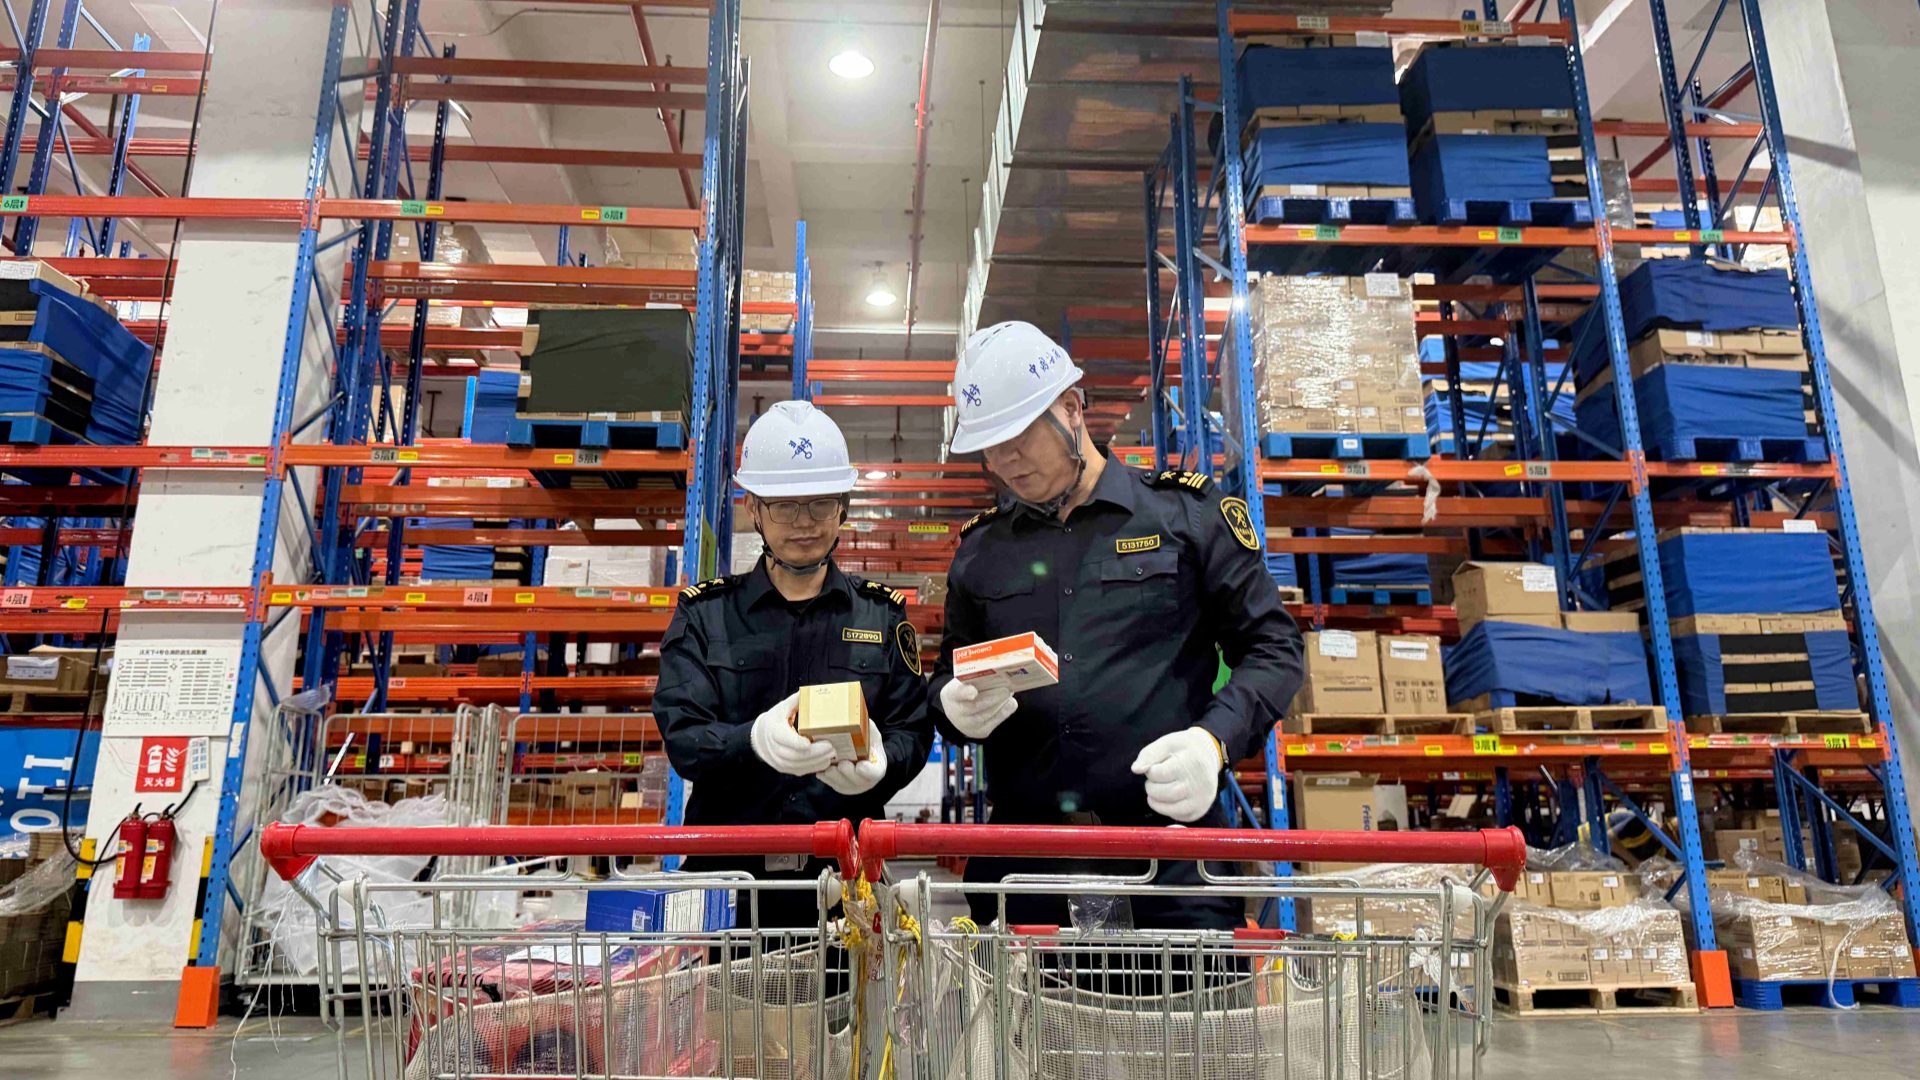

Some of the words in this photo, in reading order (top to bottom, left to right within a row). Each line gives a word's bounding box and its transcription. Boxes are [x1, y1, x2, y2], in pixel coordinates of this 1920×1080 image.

[1121, 539, 1155, 550] 5131750
[846, 631, 879, 640] 5172890
[143, 776, 176, 788] 灭火器
